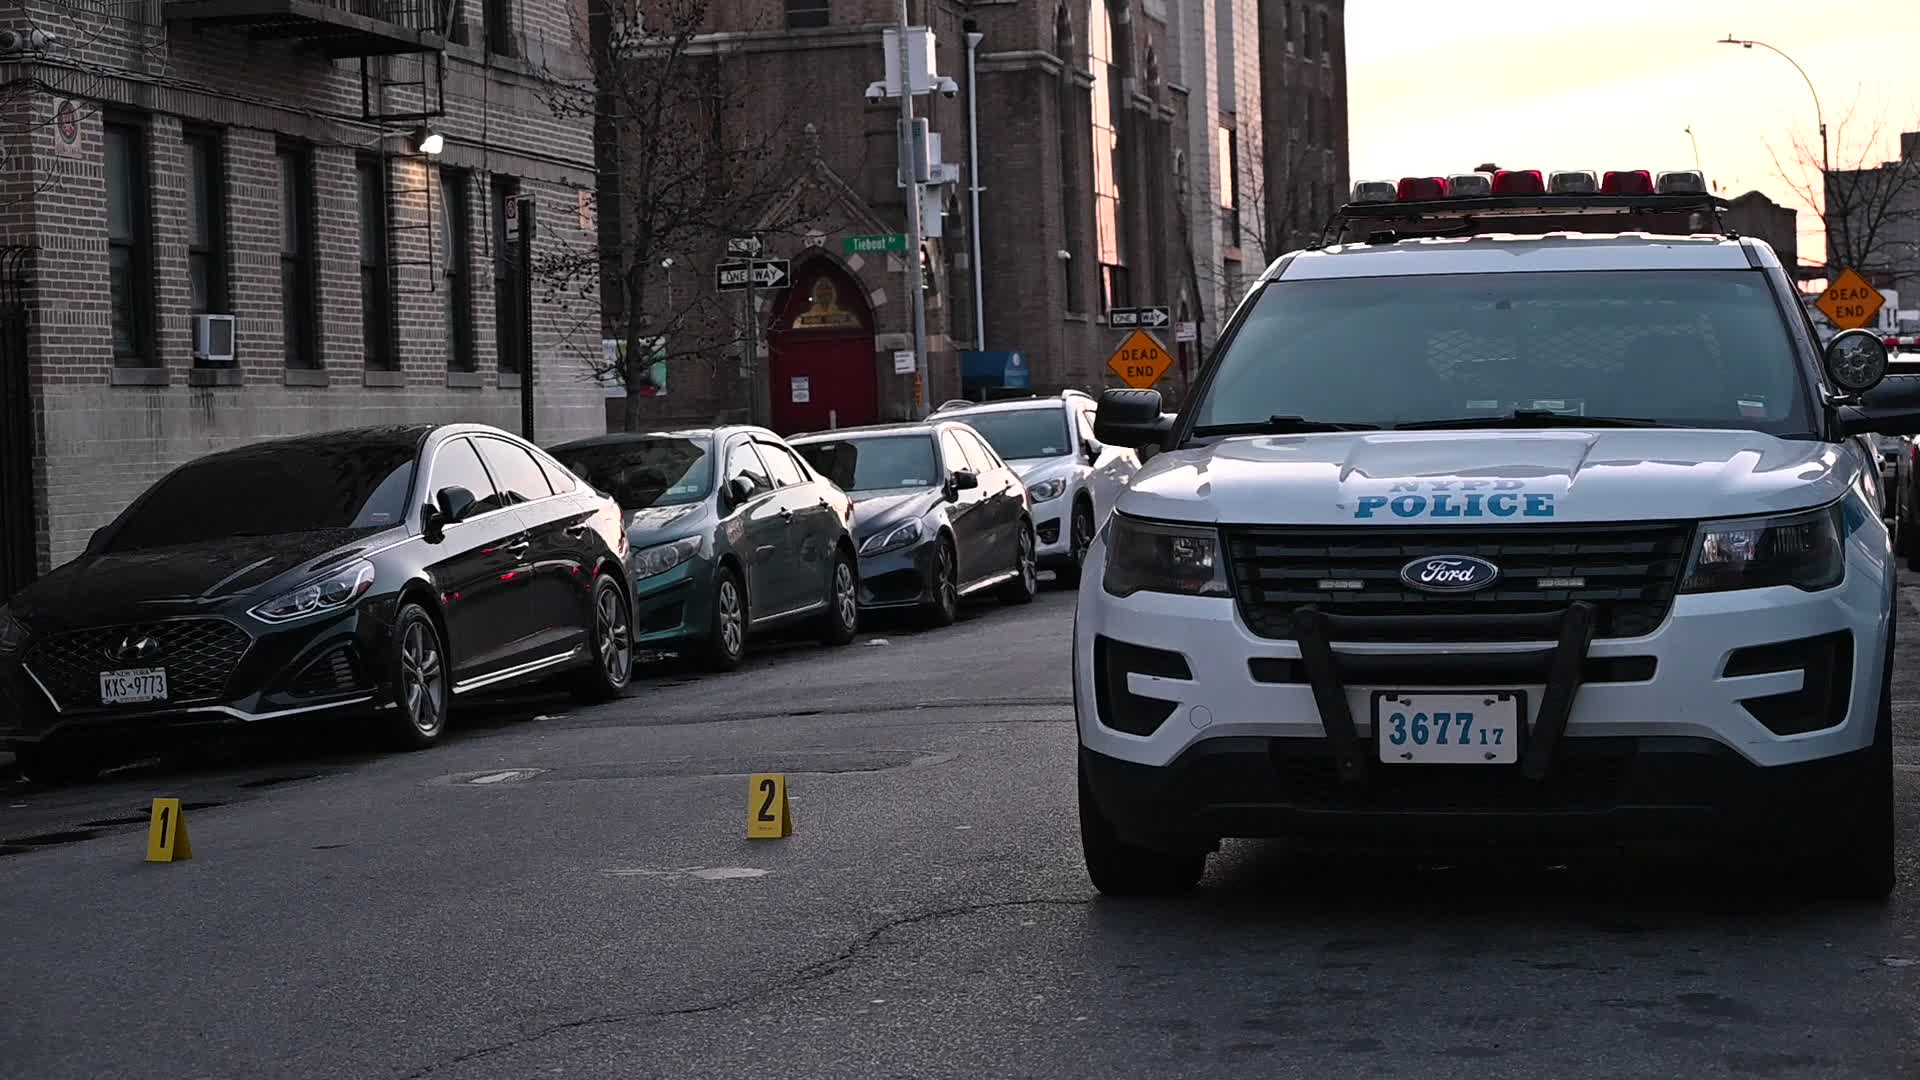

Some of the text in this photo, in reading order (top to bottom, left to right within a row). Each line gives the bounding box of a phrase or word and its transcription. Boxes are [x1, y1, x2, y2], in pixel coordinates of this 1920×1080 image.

[853, 237, 886, 250] Tiebout
[726, 269, 777, 282] ONE WAY
[1829, 287, 1869, 301] DEAD
[1836, 306, 1864, 318] END
[1121, 348, 1158, 361] DEAD
[1127, 366, 1154, 377] END
[1389, 479, 1526, 493] NYPD
[1354, 493, 1554, 519] POLICE
[1420, 559, 1476, 583] Ford
[1388, 712, 1504, 746] 3677 17
[758, 778, 776, 822] 2
[159, 806, 170, 849] 1
